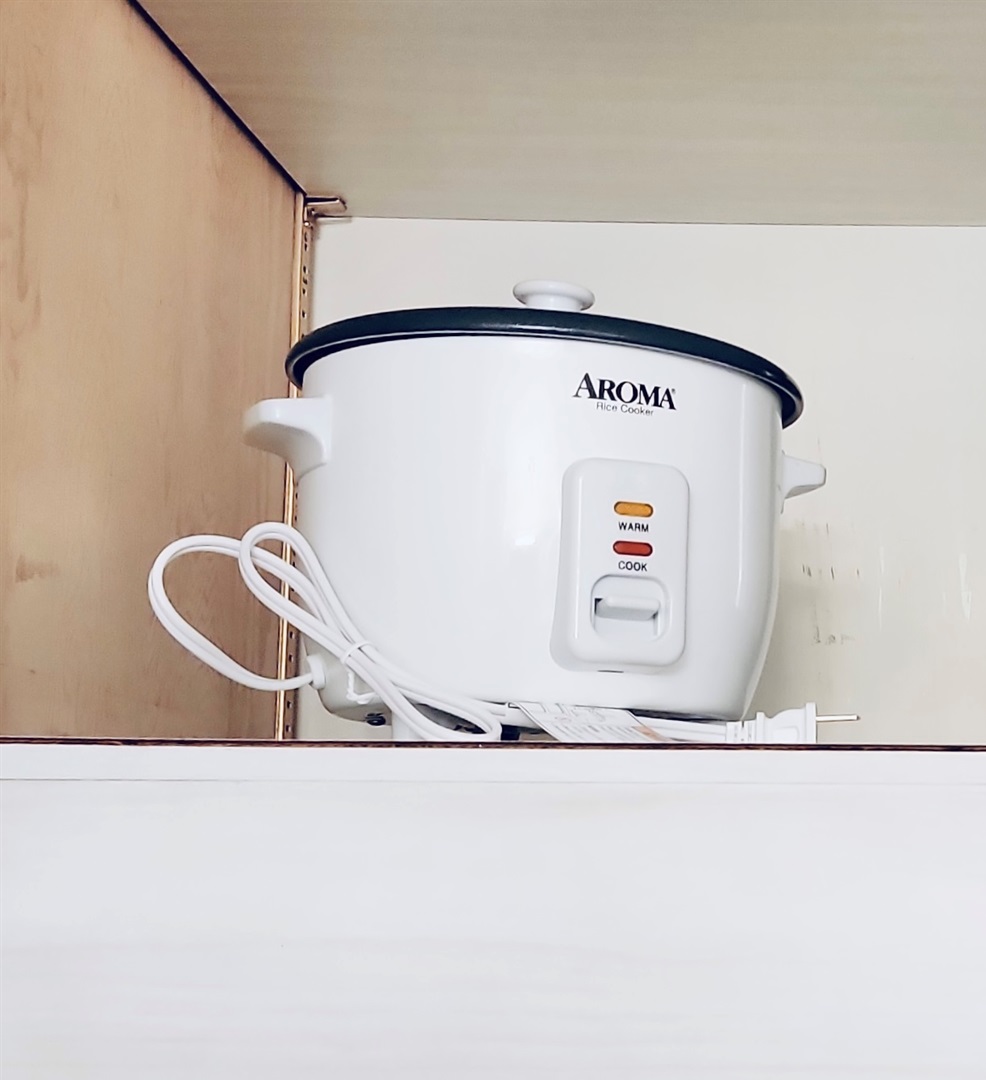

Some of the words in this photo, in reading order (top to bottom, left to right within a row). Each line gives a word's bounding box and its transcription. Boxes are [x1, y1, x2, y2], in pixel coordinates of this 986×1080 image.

[573, 372, 677, 411] AROMA
[596, 401, 618, 412] Rice
[620, 404, 654, 416] Cooker
[618, 521, 650, 533] WARM
[618, 561, 648, 572] COOK
